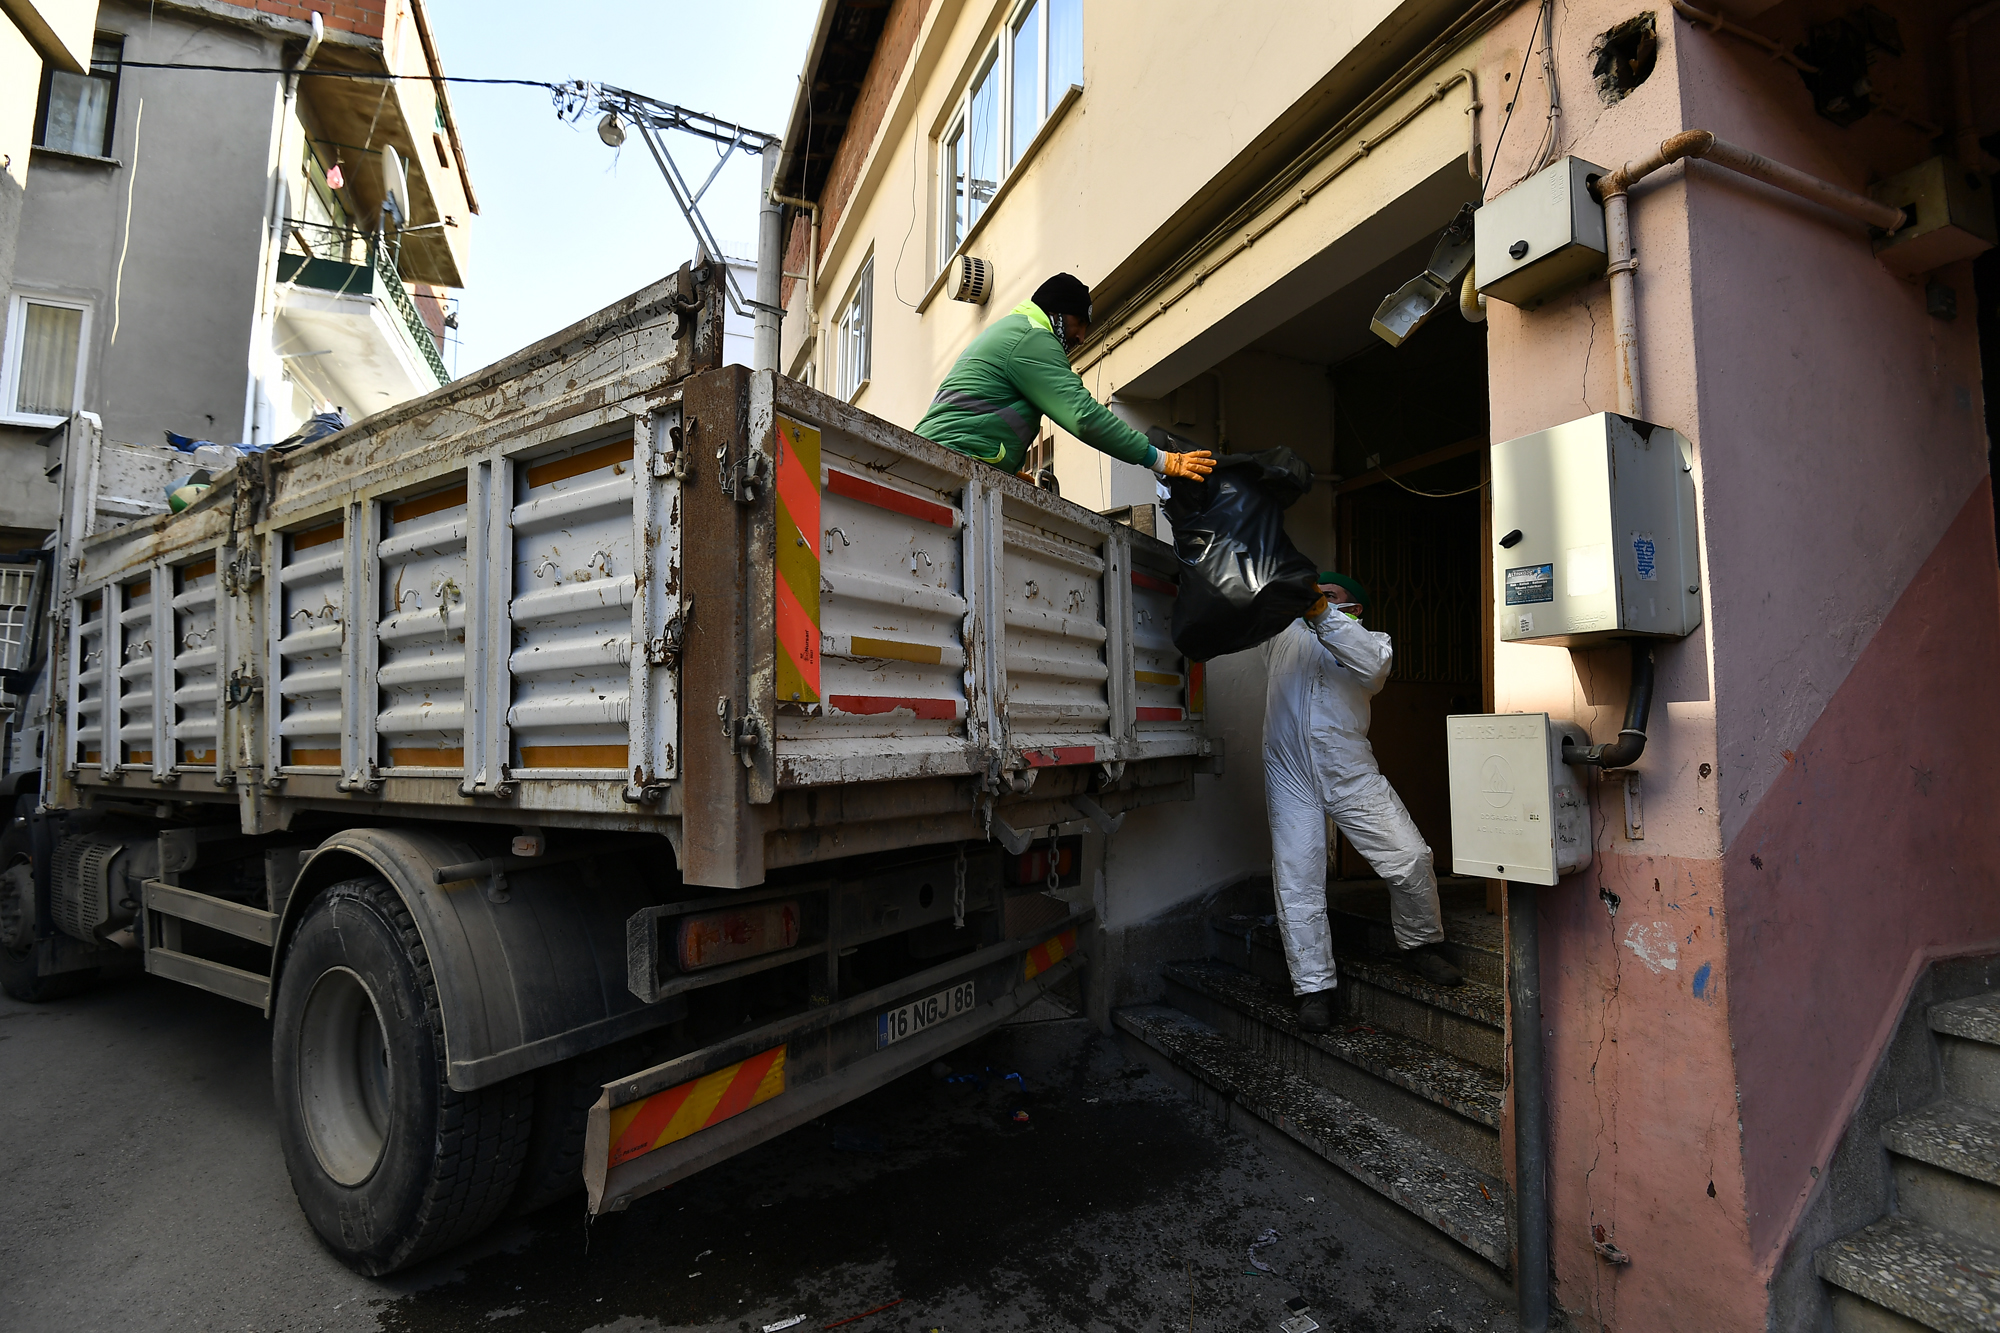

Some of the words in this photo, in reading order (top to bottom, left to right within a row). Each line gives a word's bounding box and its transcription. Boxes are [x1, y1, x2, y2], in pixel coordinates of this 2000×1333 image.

[1455, 724, 1539, 739] BURSAGAZ
[889, 1009, 908, 1040] 16
[913, 992, 950, 1031] NGJ
[954, 983, 973, 1012] 86
[880, 1033, 888, 1042] TR
